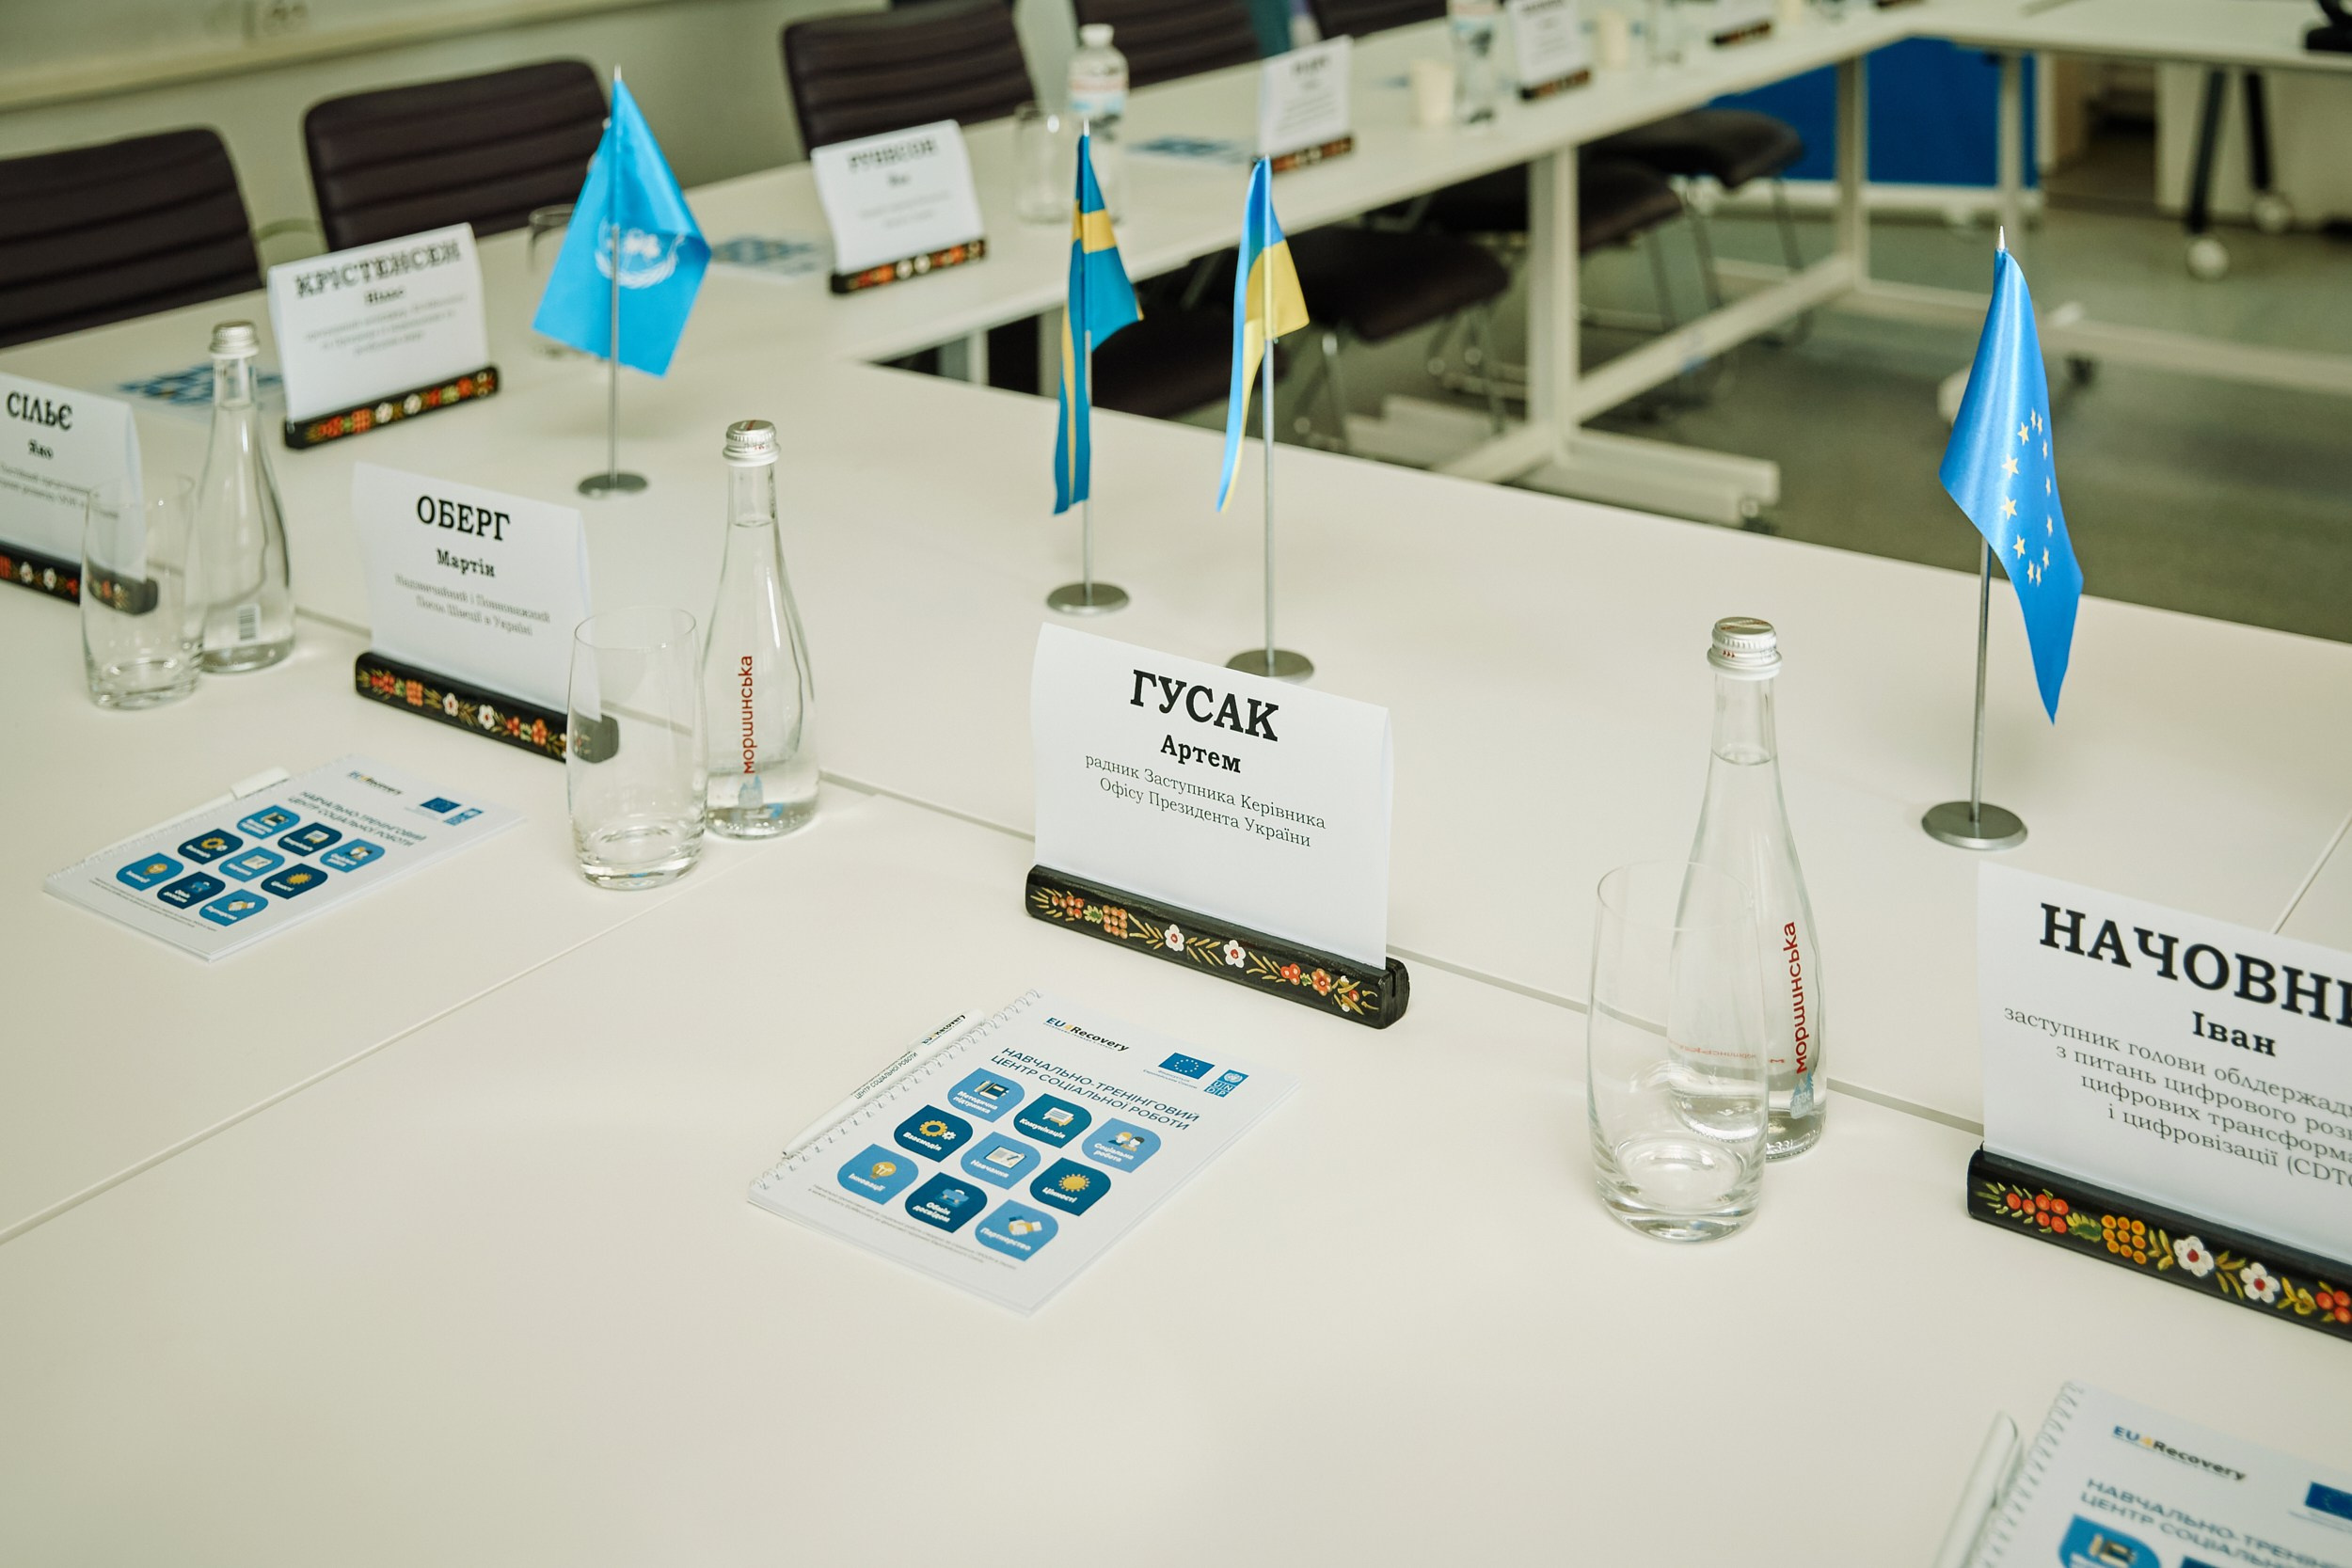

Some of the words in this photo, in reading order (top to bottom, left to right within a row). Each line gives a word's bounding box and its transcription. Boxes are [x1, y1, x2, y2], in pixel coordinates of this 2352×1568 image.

[7, 391, 72, 431] СІЛЬЄ
[417, 496, 510, 541] ОБЕРГ
[437, 548, 496, 578] Мартін
[739, 656, 757, 774] моршинська
[1130, 669, 1279, 742] ГУСАК
[1160, 734, 1241, 773] Артем
[1085, 754, 1140, 779] радник
[1144, 768, 1235, 806] Заступника
[1241, 794, 1327, 830] Керівника
[1100, 777, 1144, 804] Офісу
[1149, 792, 1240, 829] Президента
[1245, 816, 1311, 847] України
[1784, 922, 1809, 1074] моршинська
[2192, 1011, 2277, 1057] Іван
[1002, 1048, 1200, 1122] НАВЧАЛЬНО-ТРЕНІНГОВИЙ
[2004, 1006, 2121, 1052] заступник
[2128, 1042, 2206, 1076] голови
[2215, 1068, 2352, 1118] облдержад
[2056, 1045, 2067, 1058] з
[2074, 1049, 2156, 1085] питань
[2164, 1075, 2296, 1125] цифрового
[958, 1090, 998, 1111] Методична
[991, 1054, 1038, 1075] ЦЕНТР
[1039, 1073, 1132, 1110] СОЦІАЛЬНОЇ
[1128, 1105, 1190, 1131] РОБОТИ
[2081, 1075, 2201, 1121] цифрових
[1019, 1117, 1066, 1139] Комунікація
[2108, 1103, 2115, 1119] і
[2122, 1111, 2279, 1167] цифровізації
[970, 1160, 1009, 1179] Навчання
[1094, 1143, 1135, 1161] Соціальна
[926, 1201, 951, 1215] Обмін
[1041, 1186, 1078, 1204] Цінності
[979, 1227, 1032, 1252] Партнерство
[2112, 1424, 2248, 1482] EU4Recovery
[2080, 1492, 2154, 1527] ЦЕНТР
